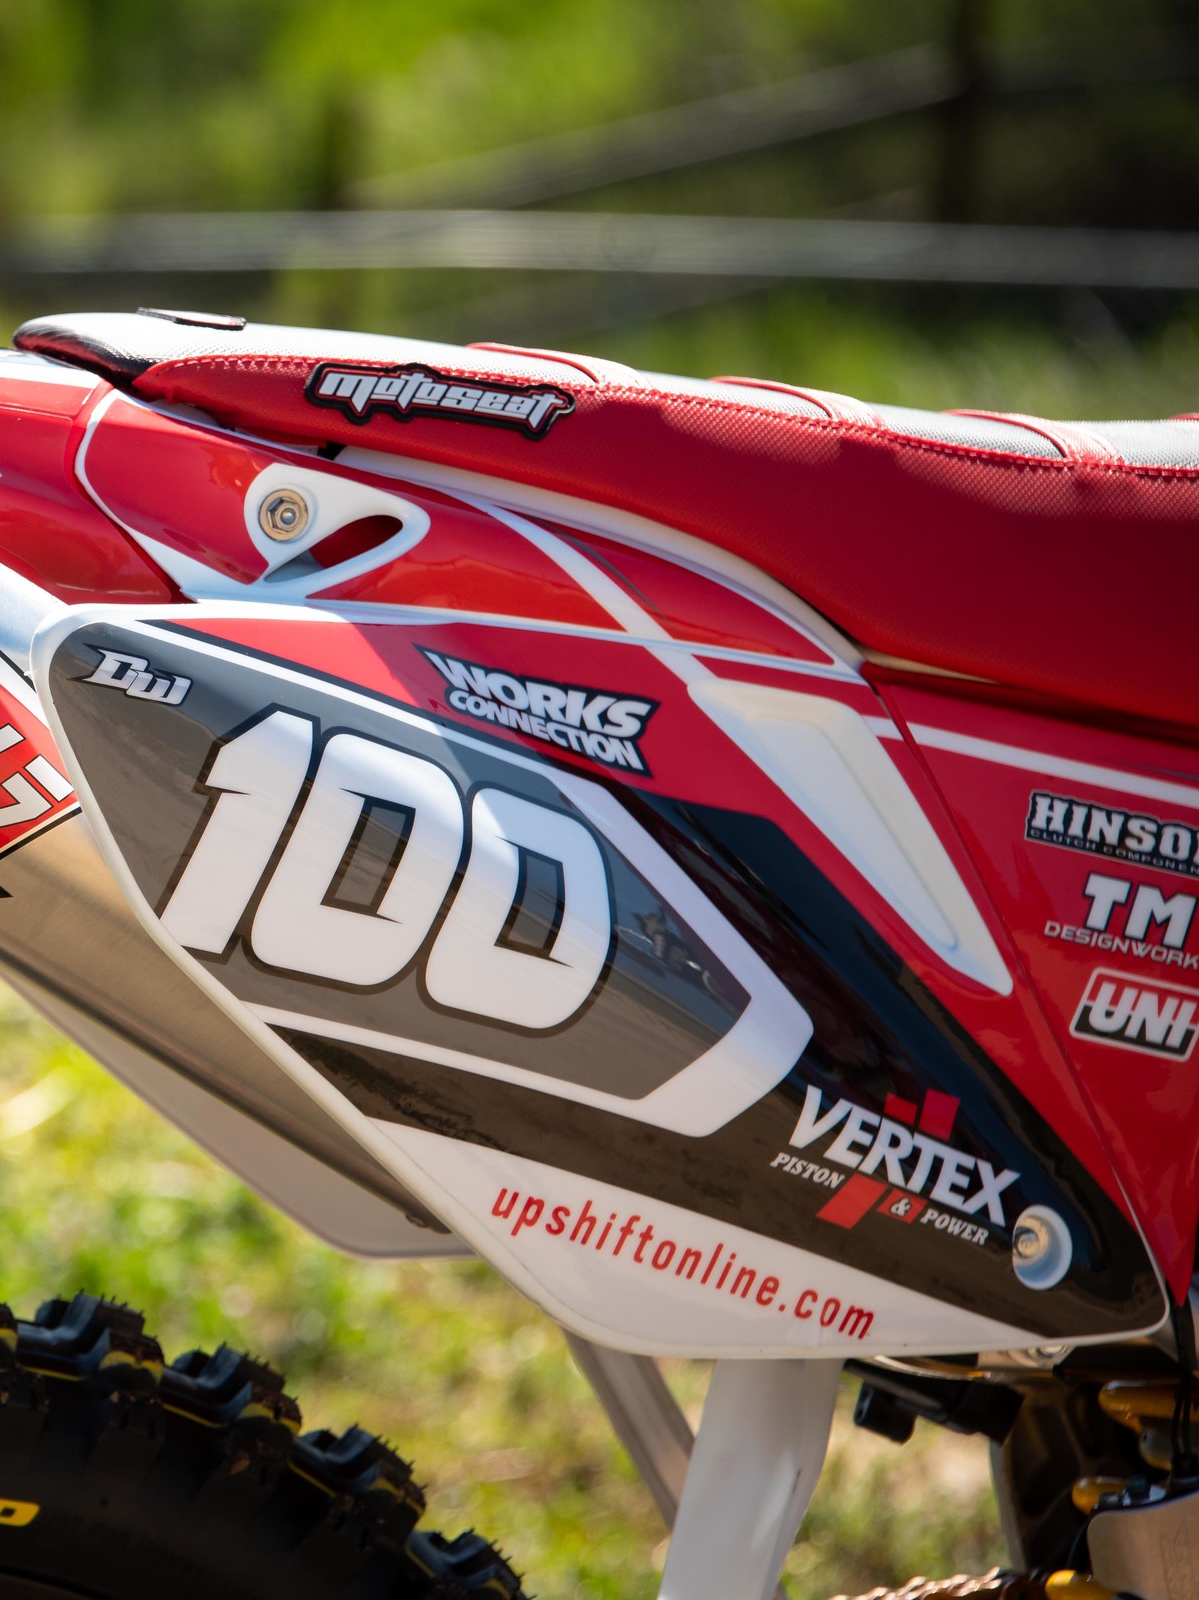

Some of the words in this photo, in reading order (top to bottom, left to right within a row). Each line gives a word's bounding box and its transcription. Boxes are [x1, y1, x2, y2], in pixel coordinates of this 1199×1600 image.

[318, 372, 564, 429] motoseat
[82, 648, 193, 705] DW
[423, 650, 652, 738] WORKS
[449, 690, 645, 771] CONNECTION
[1030, 828, 1097, 851] CLUTCH
[1031, 794, 1199, 864] HINSO
[159, 710, 612, 1030] 100
[1084, 872, 1197, 950] TM
[1088, 982, 1197, 1050] UNI
[788, 1084, 1021, 1228] VERTEX
[769, 1152, 846, 1189] PISTON
[890, 1197, 913, 1217] &
[920, 1208, 990, 1246] POWER
[491, 1187, 875, 1341] upshiftonline.com
